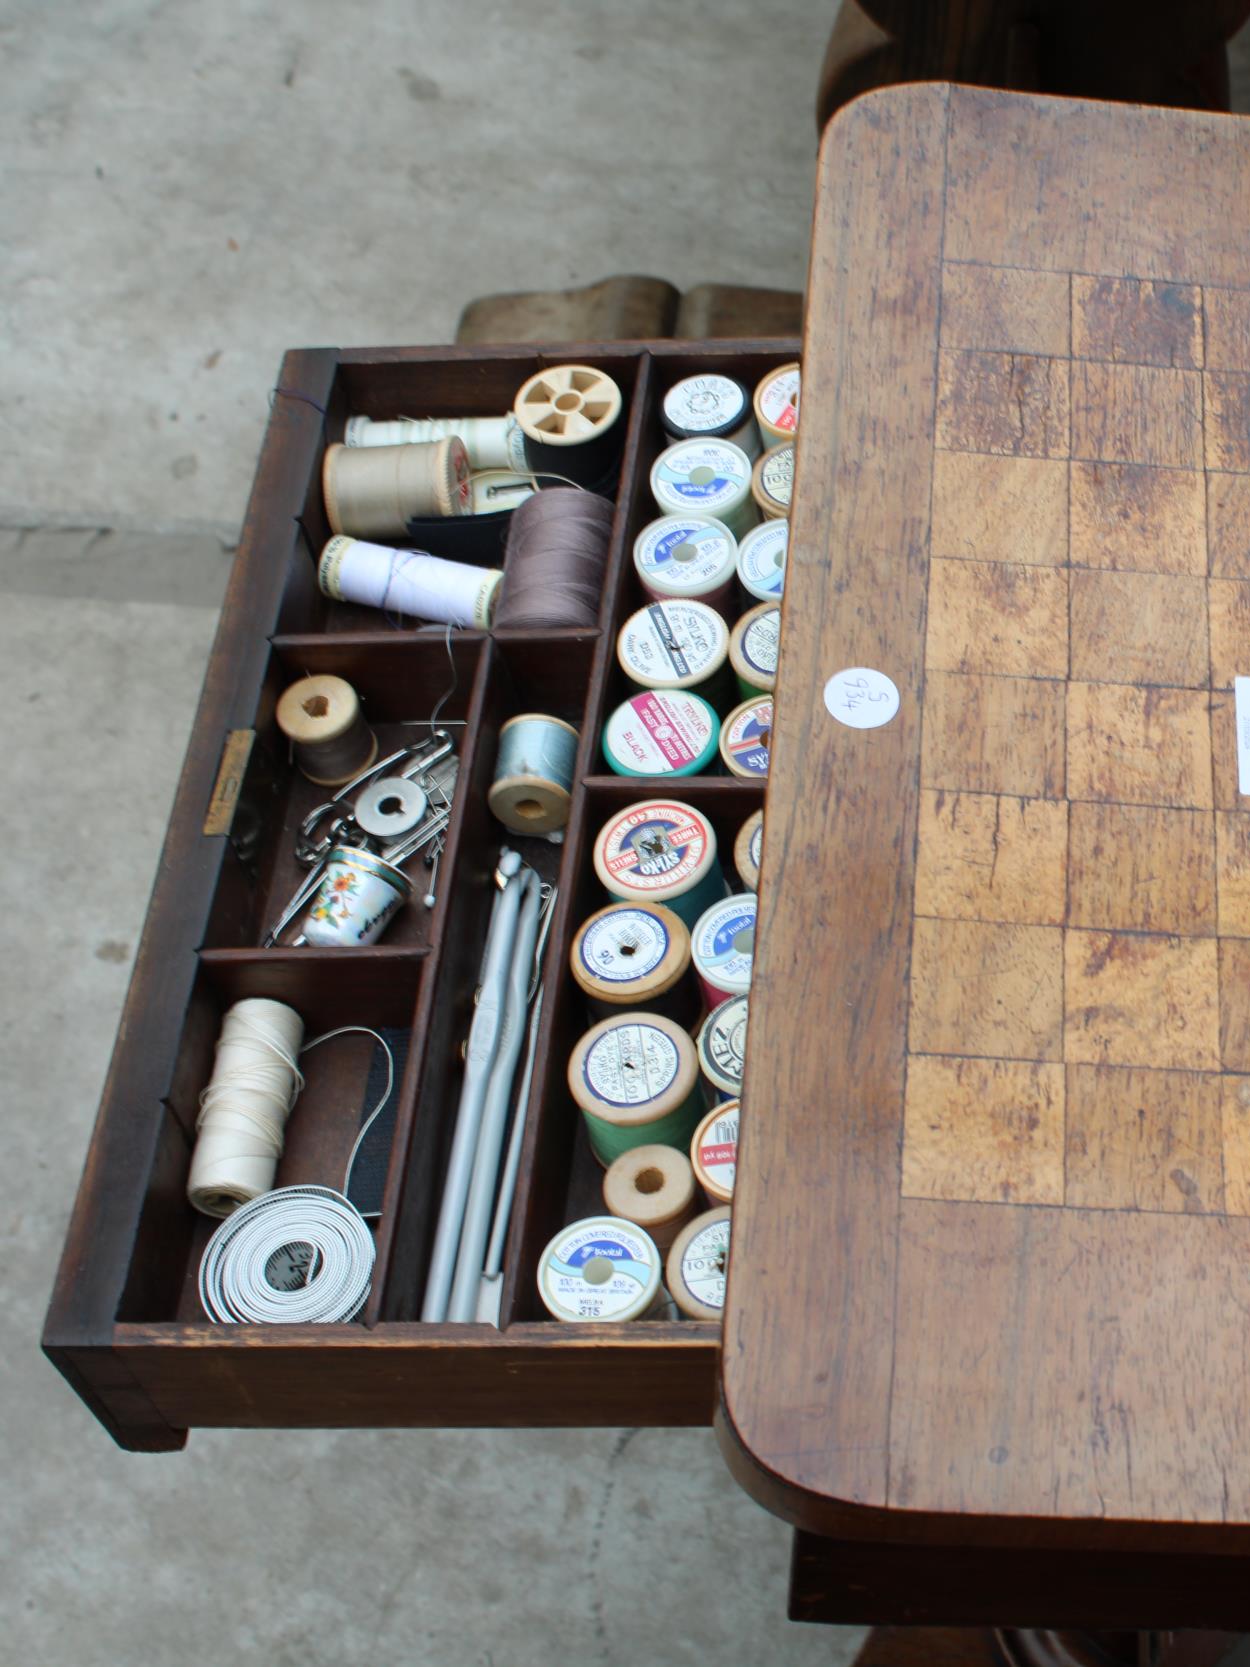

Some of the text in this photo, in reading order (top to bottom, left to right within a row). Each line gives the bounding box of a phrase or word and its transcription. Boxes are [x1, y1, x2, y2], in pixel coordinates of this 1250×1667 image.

[684, 617, 708, 654] SYLKO
[842, 678, 869, 712] 934
[622, 731, 649, 763] BLACK
[642, 708, 679, 760] FAST DYED
[607, 825, 699, 873] THREE SHELLS
[639, 851, 680, 876] SYLKO
